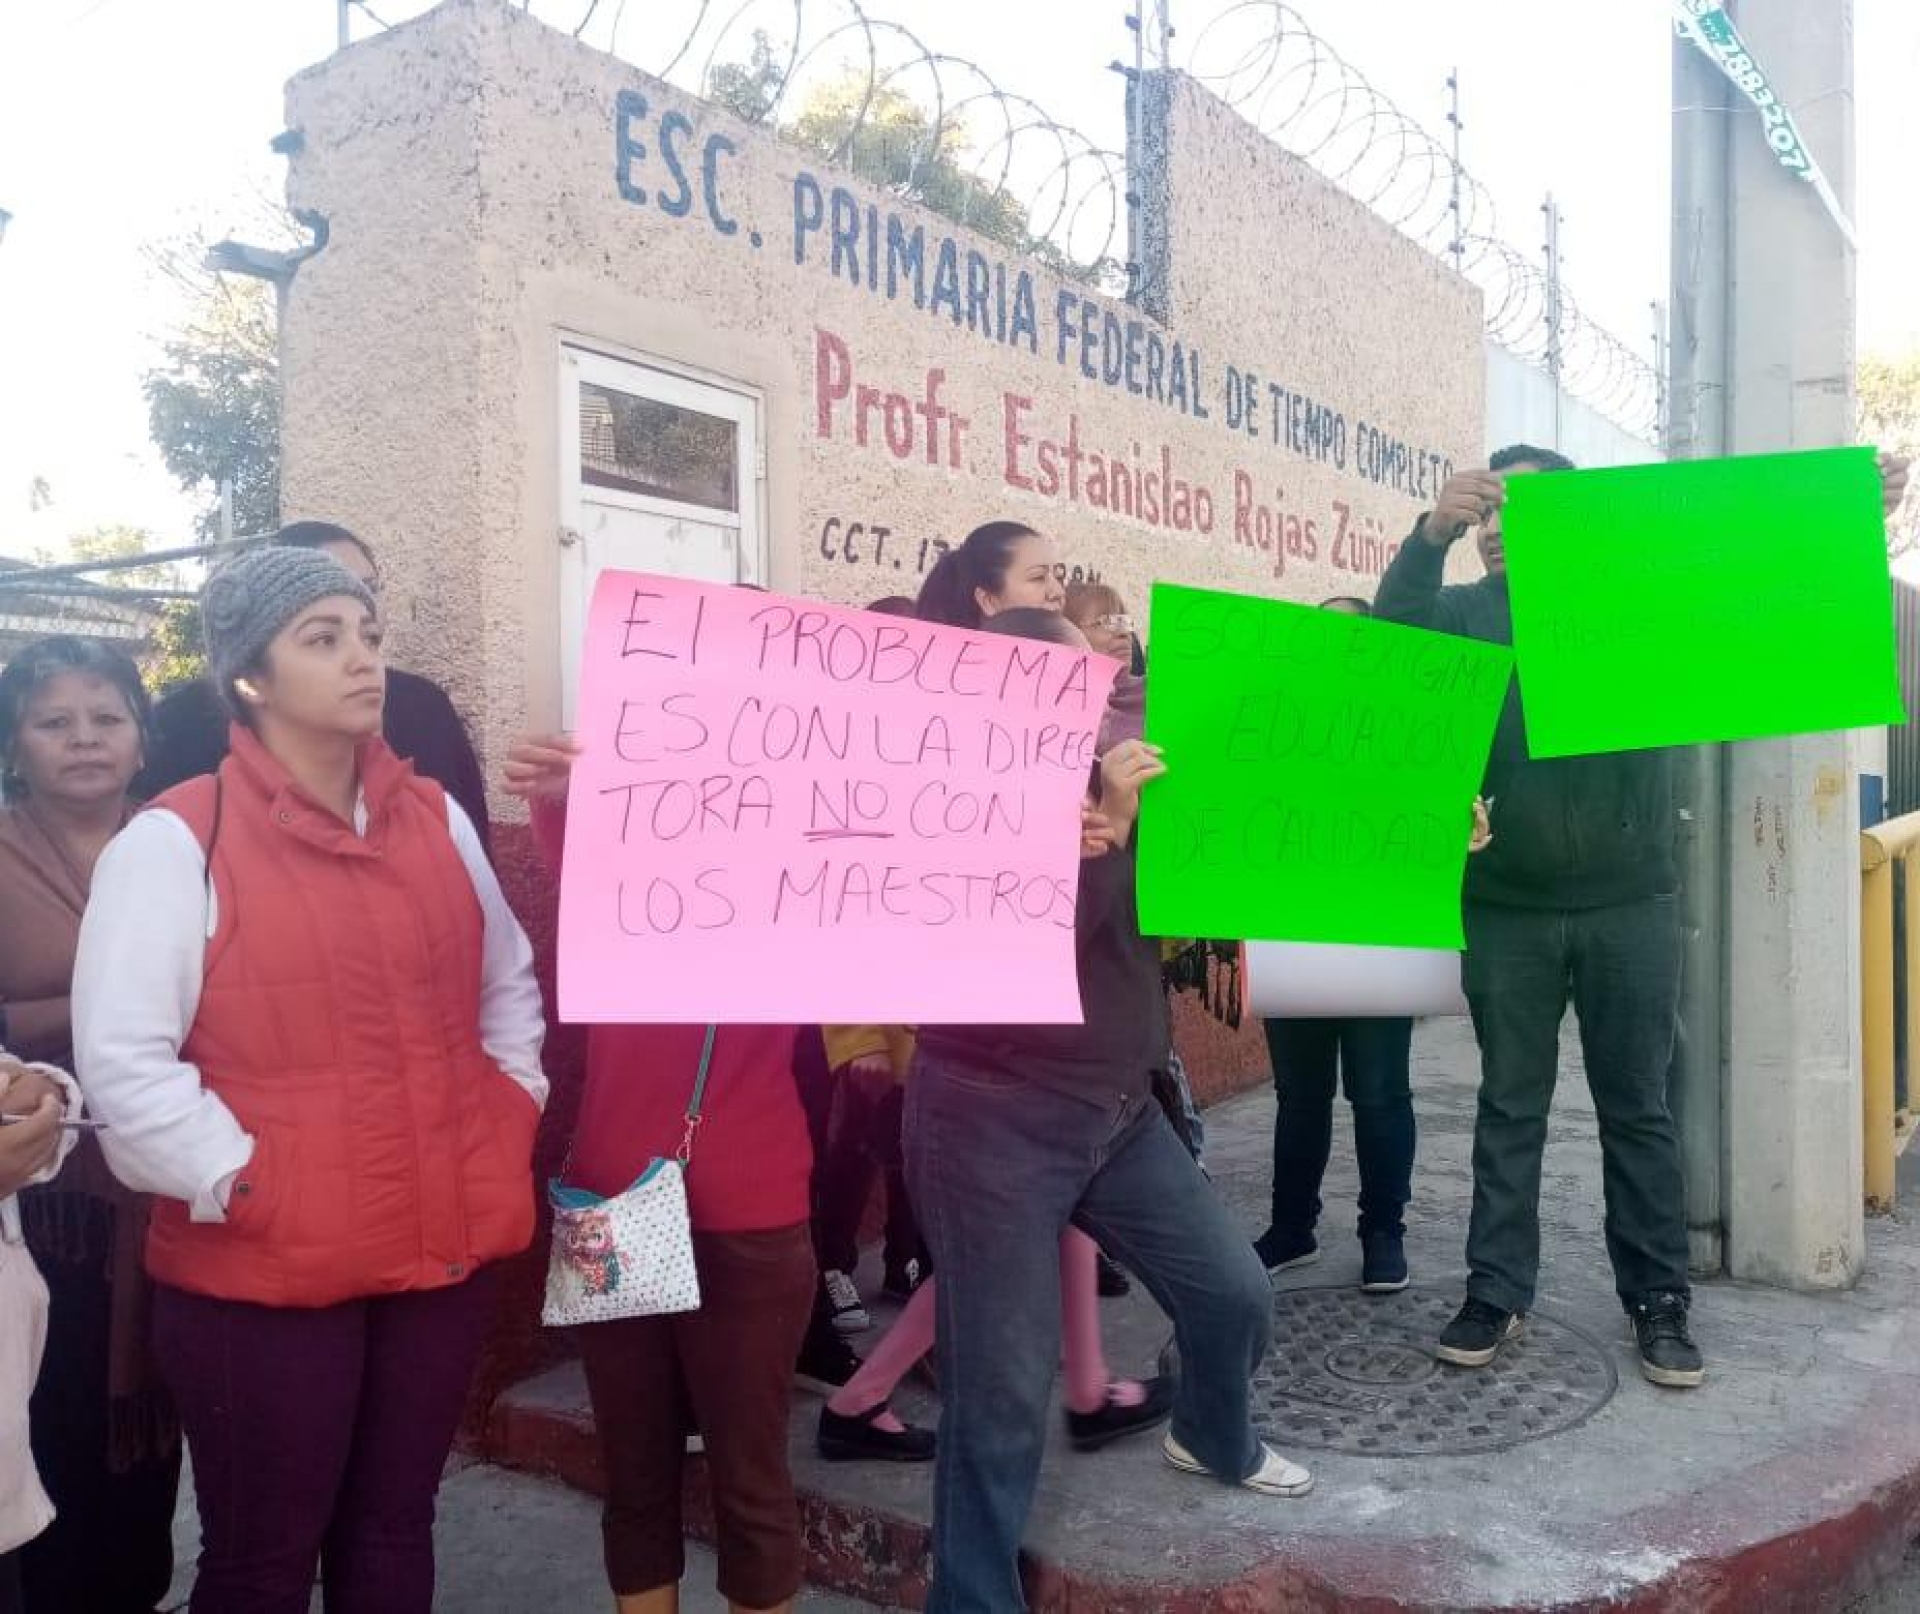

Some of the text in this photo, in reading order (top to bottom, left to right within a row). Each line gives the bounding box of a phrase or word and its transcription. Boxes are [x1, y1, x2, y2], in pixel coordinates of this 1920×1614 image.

[615, 87, 763, 248] ESC.
[792, 171, 1038, 354] PRIMARIA
[1055, 288, 1209, 418] FEDERAL
[1225, 365, 1259, 436] DE
[1268, 382, 1346, 470] TIEMPO
[1002, 392, 1213, 536] Estanislao
[1235, 468, 1318, 578] Rojas
[820, 516, 902, 570] CCT.
[749, 604, 1089, 708] PROBLEMA
[874, 714, 957, 766] LA
[599, 774, 1025, 844] TORA NO CON
[618, 859, 1077, 936] LOS MAESTROS
